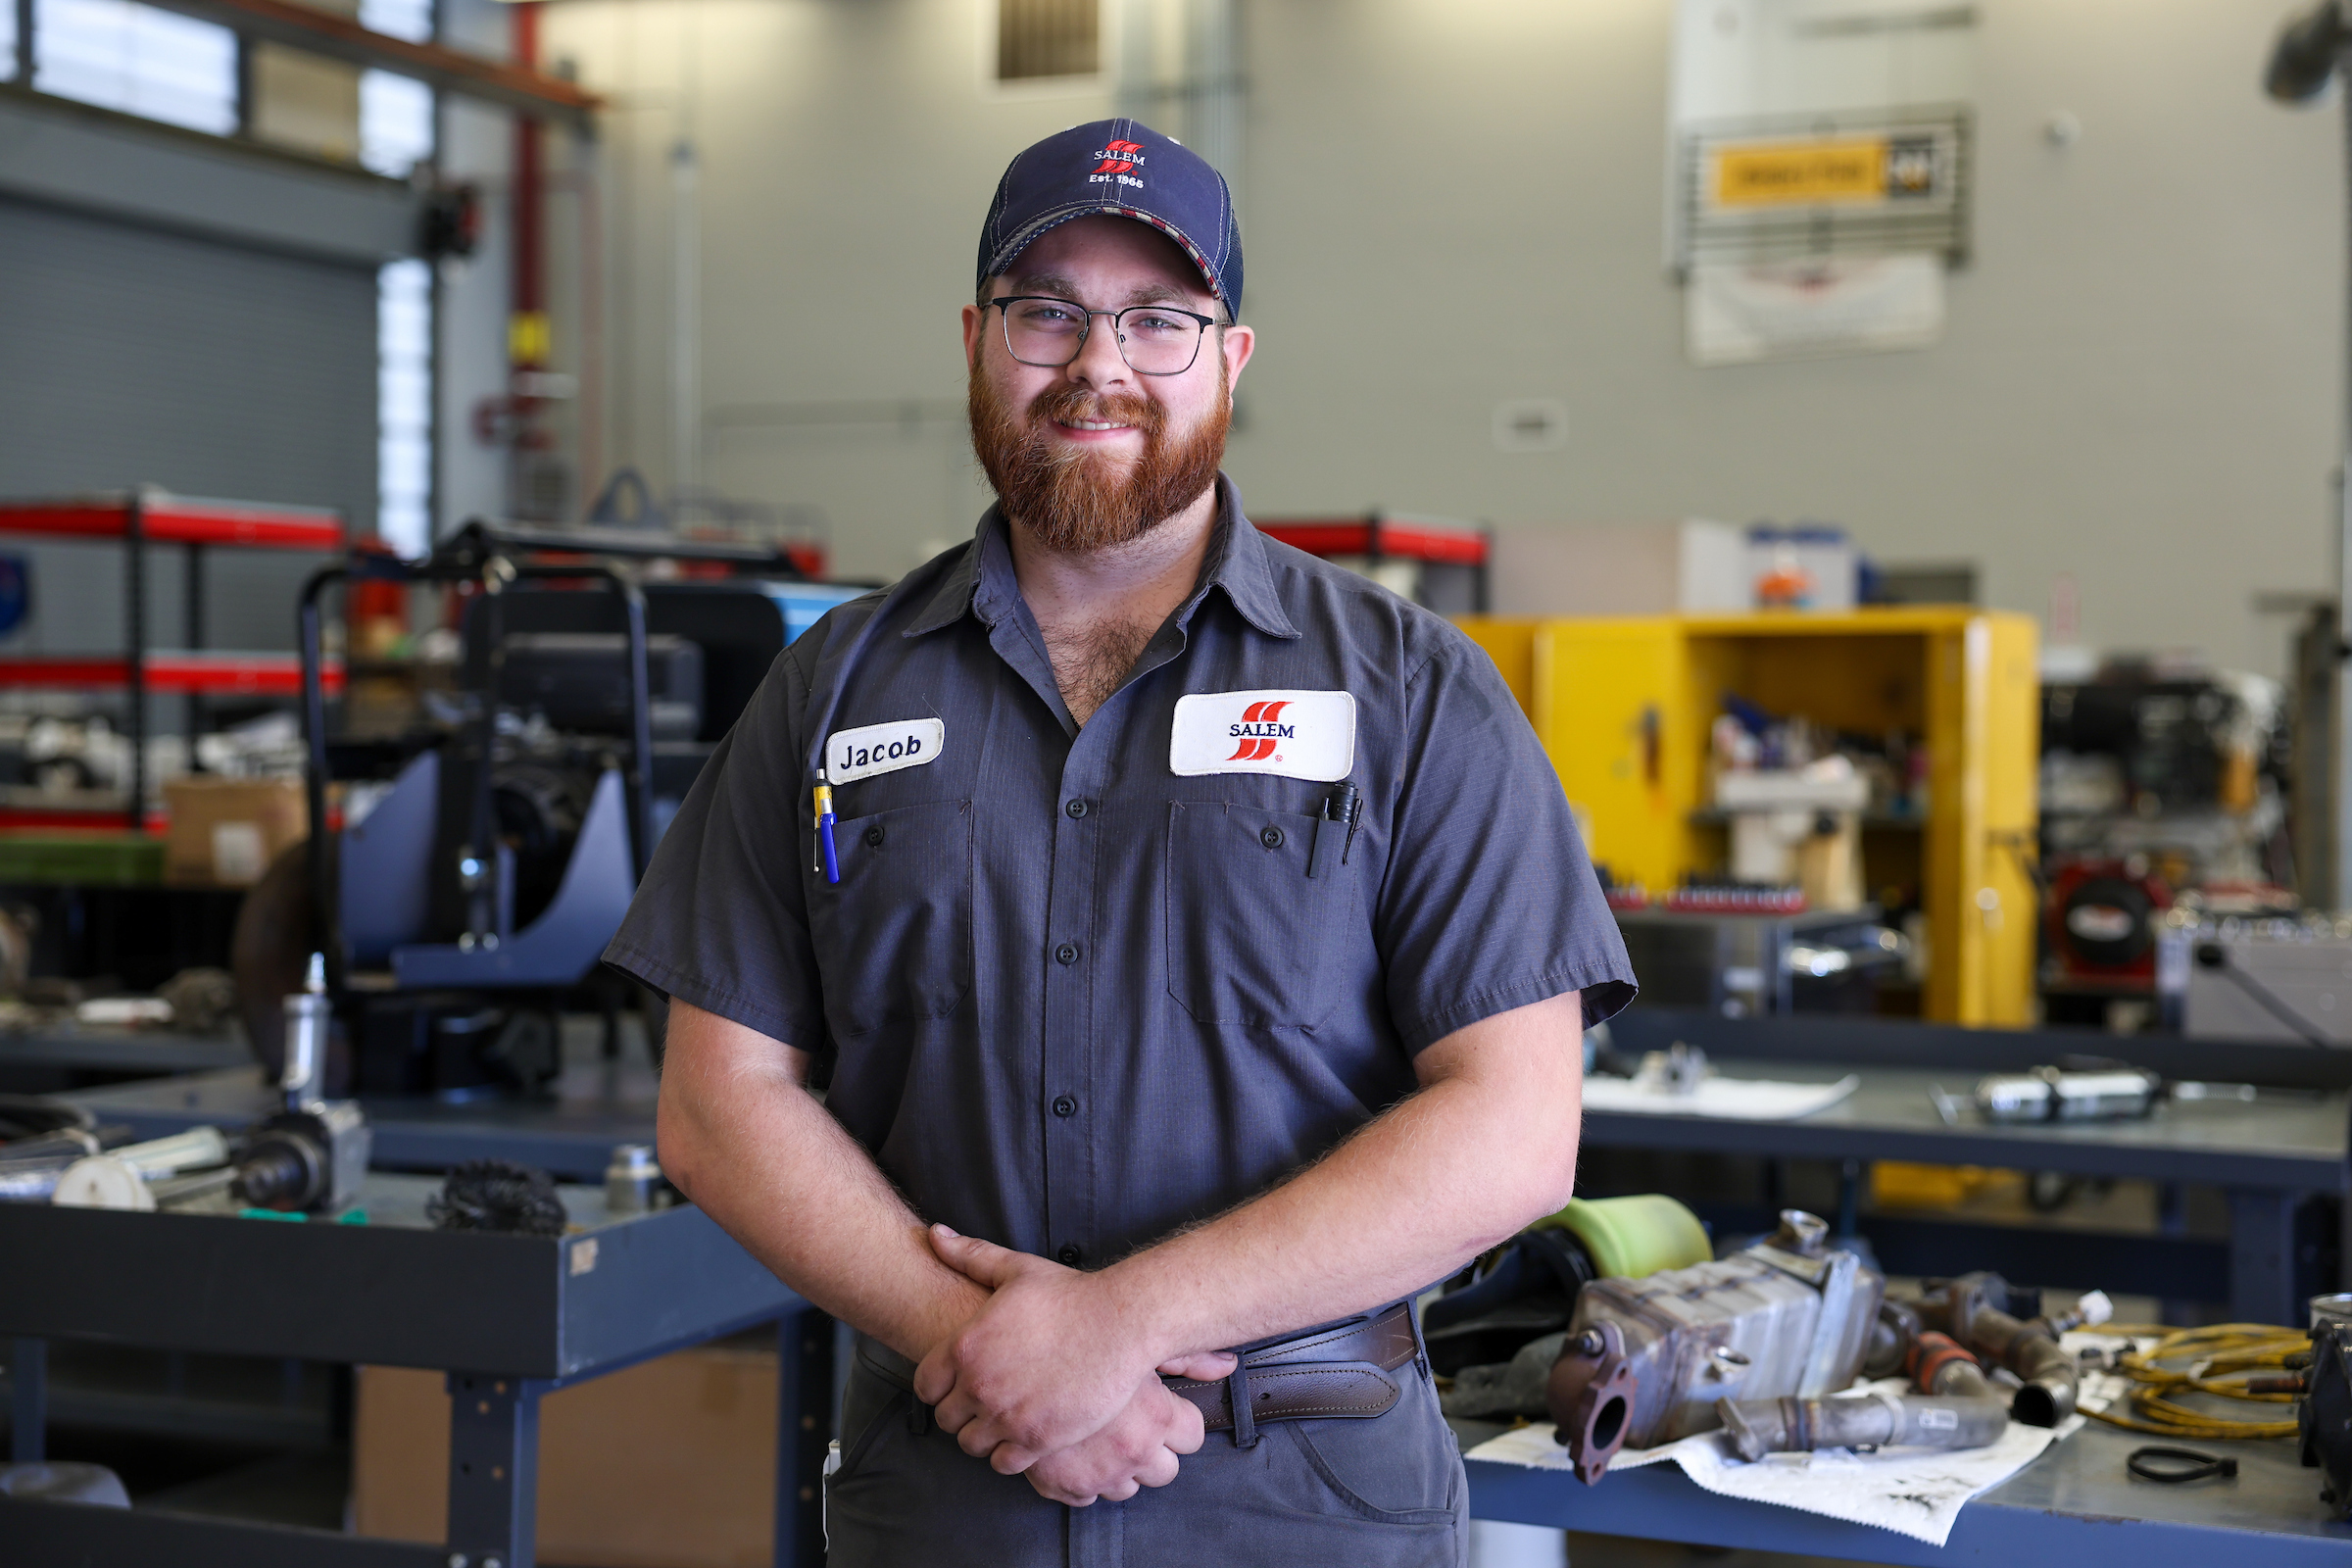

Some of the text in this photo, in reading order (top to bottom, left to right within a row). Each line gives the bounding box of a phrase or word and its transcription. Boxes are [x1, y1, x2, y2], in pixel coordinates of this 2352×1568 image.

[1094, 150, 1145, 166] SALEM
[1089, 173, 1113, 183] Est.
[1229, 723, 1296, 739] SALEM
[840, 735, 921, 769] Jacob
